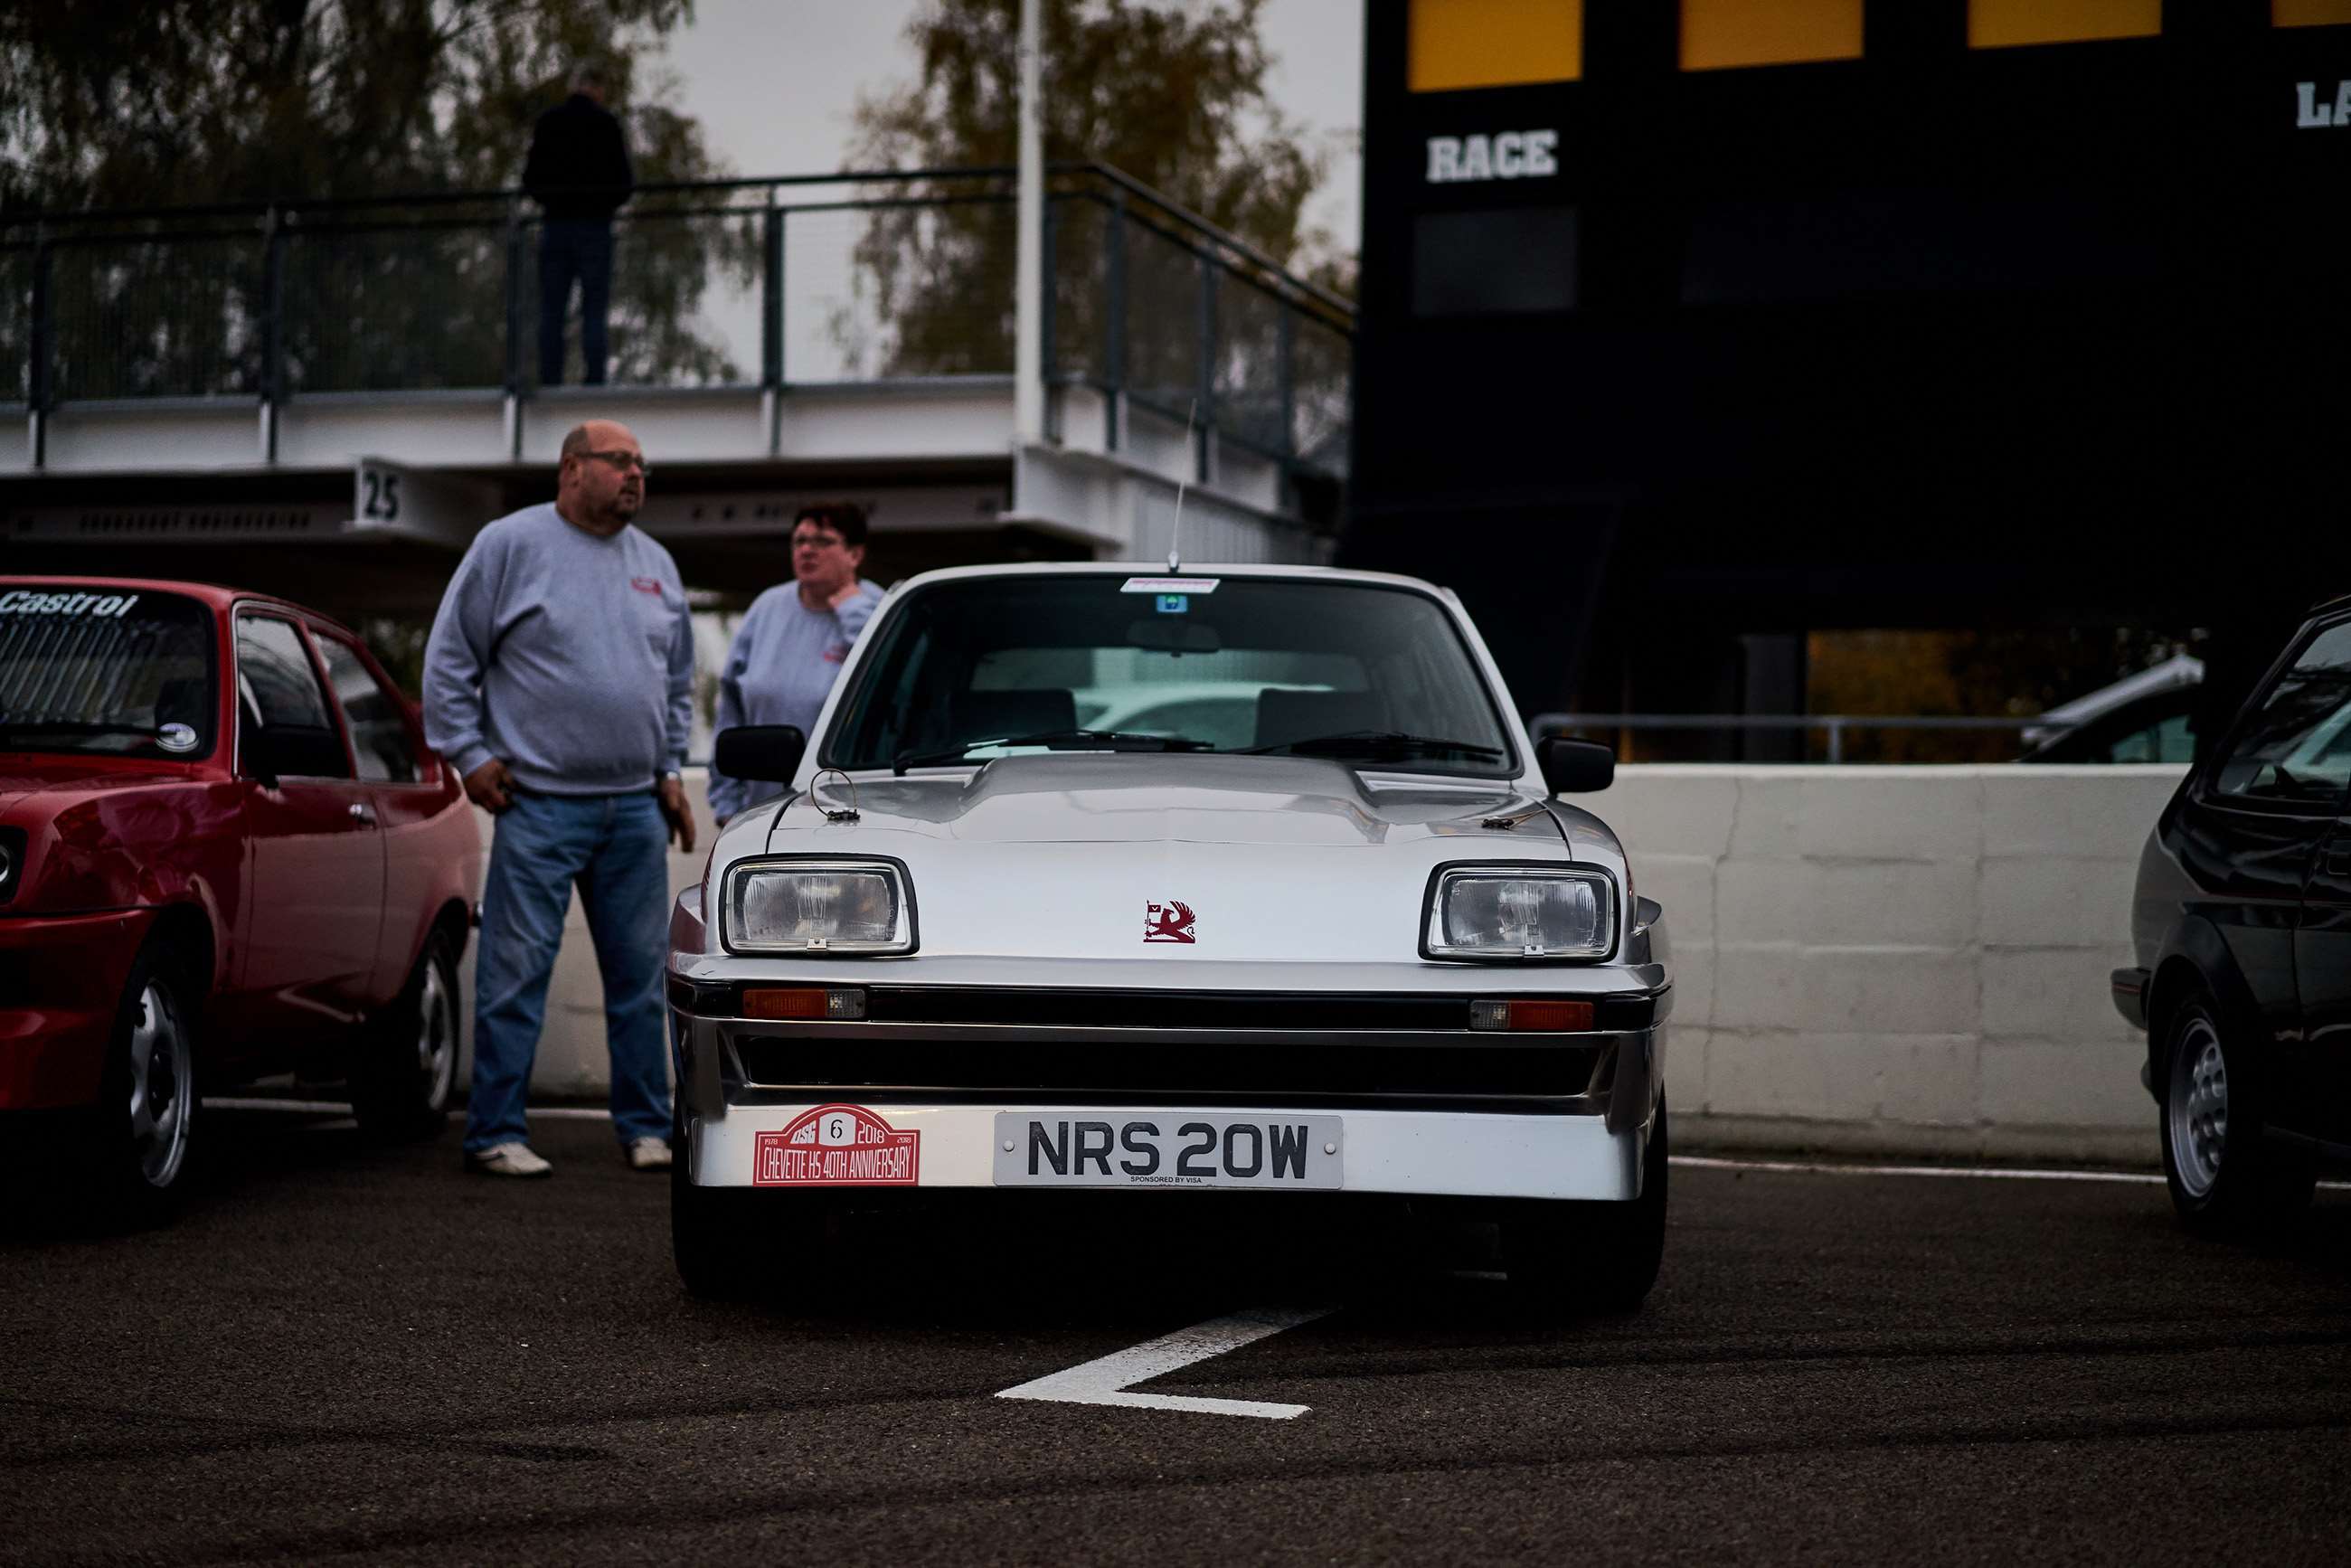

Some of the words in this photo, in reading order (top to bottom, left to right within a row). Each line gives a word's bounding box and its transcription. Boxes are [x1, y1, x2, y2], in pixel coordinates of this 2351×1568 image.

[1426, 129, 1559, 183] RACE
[364, 472, 399, 521] 25
[0, 590, 138, 618] Castrol
[830, 1119, 843, 1139] 6
[858, 1120, 884, 1144] 2018
[763, 1147, 807, 1179] CHEVETTE
[808, 1150, 821, 1179] HS
[823, 1150, 847, 1178] 40TH
[849, 1145, 911, 1178] ANNIVERSARY
[1028, 1120, 1160, 1176] NRS
[1176, 1122, 1308, 1179] 20W
